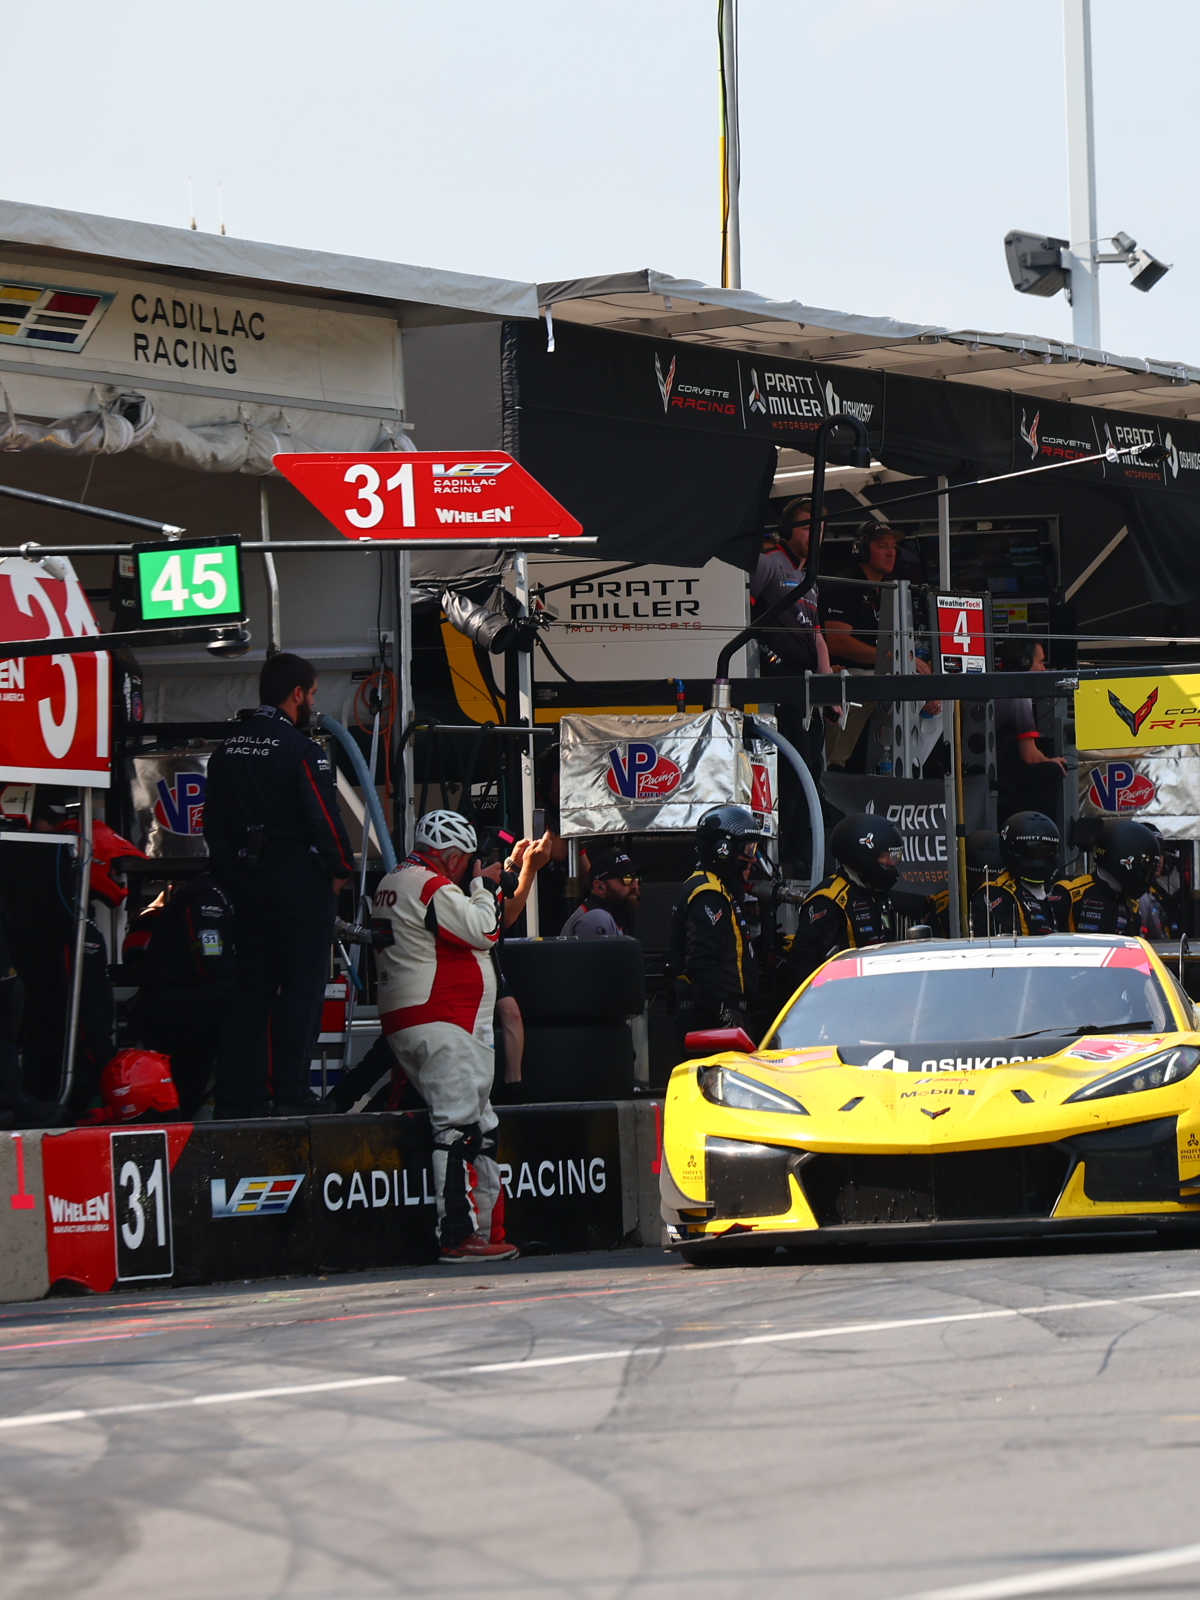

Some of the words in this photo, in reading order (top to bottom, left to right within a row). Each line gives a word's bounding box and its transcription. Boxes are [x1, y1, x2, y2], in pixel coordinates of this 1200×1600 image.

[131, 293, 265, 340] CADILLAC
[134, 332, 237, 374] RACING
[677, 384, 729, 399] CORVETTE
[764, 372, 815, 395] PRATT
[671, 396, 736, 415] RACING
[768, 397, 824, 418] MILLER
[772, 421, 821, 431] MOTORSPOR
[1115, 426, 1154, 445] PRATT
[1042, 436, 1091, 449] CORVETTE
[433, 478, 497, 487] CADILLAC
[343, 463, 416, 528] 31
[150, 552, 227, 611] 45
[570, 578, 700, 598] PRATT
[571, 599, 700, 620] MILLER
[939, 599, 981, 608] WeatherTech
[571, 621, 702, 633] MOTORSPORTS
[953, 611, 970, 653] 4
[224, 736, 280, 746] CADILLAC
[226, 747, 269, 756] RACING
[608, 742, 657, 799] VP
[639, 771, 681, 792] Racing
[1089, 762, 1134, 812] VP
[156, 771, 207, 835] VP
[1118, 786, 1154, 805] Racing
[900, 1089, 954, 1098] Mobil
[323, 1168, 436, 1212] CADILL
[499, 1157, 607, 1199] RACING
[48, 1191, 110, 1223] WHELEN
[119, 1159, 166, 1249] 31
